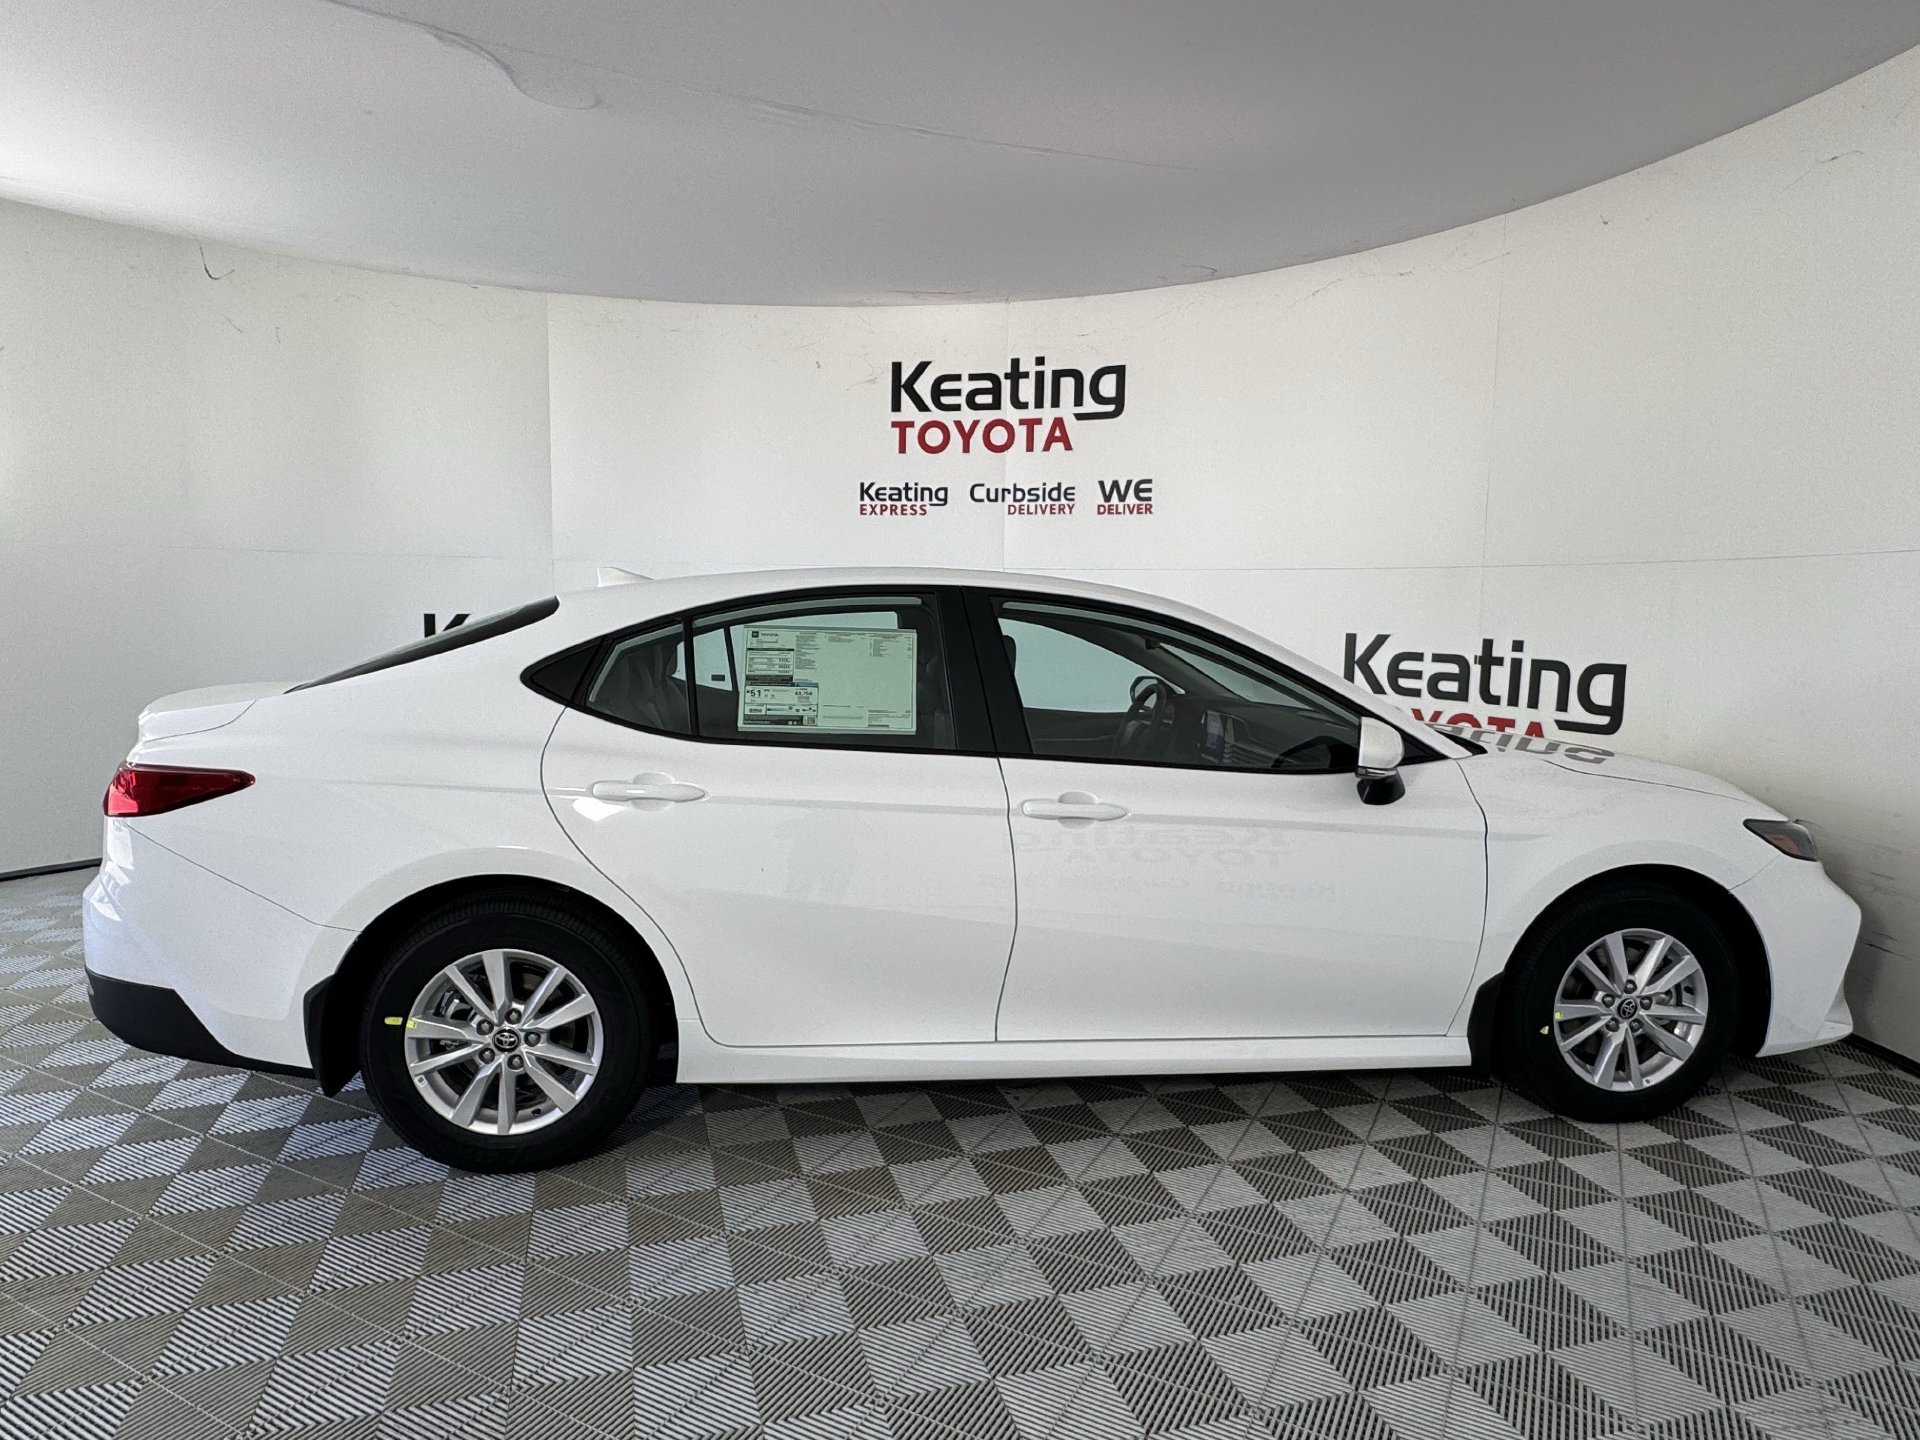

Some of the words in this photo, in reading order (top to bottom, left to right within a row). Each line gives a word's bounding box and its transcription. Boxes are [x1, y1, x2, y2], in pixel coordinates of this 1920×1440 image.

[891, 356, 1126, 421] Keating
[891, 417, 1073, 454] TOYOTA
[860, 483, 949, 507] Keating
[970, 483, 1076, 504] Curbside
[1098, 479, 1153, 503] WE
[859, 504, 928, 516] EXPRESS
[1007, 504, 1076, 516] DELIVERY
[1097, 504, 1153, 516] DELIVER
[1344, 633, 1628, 735] Keating
